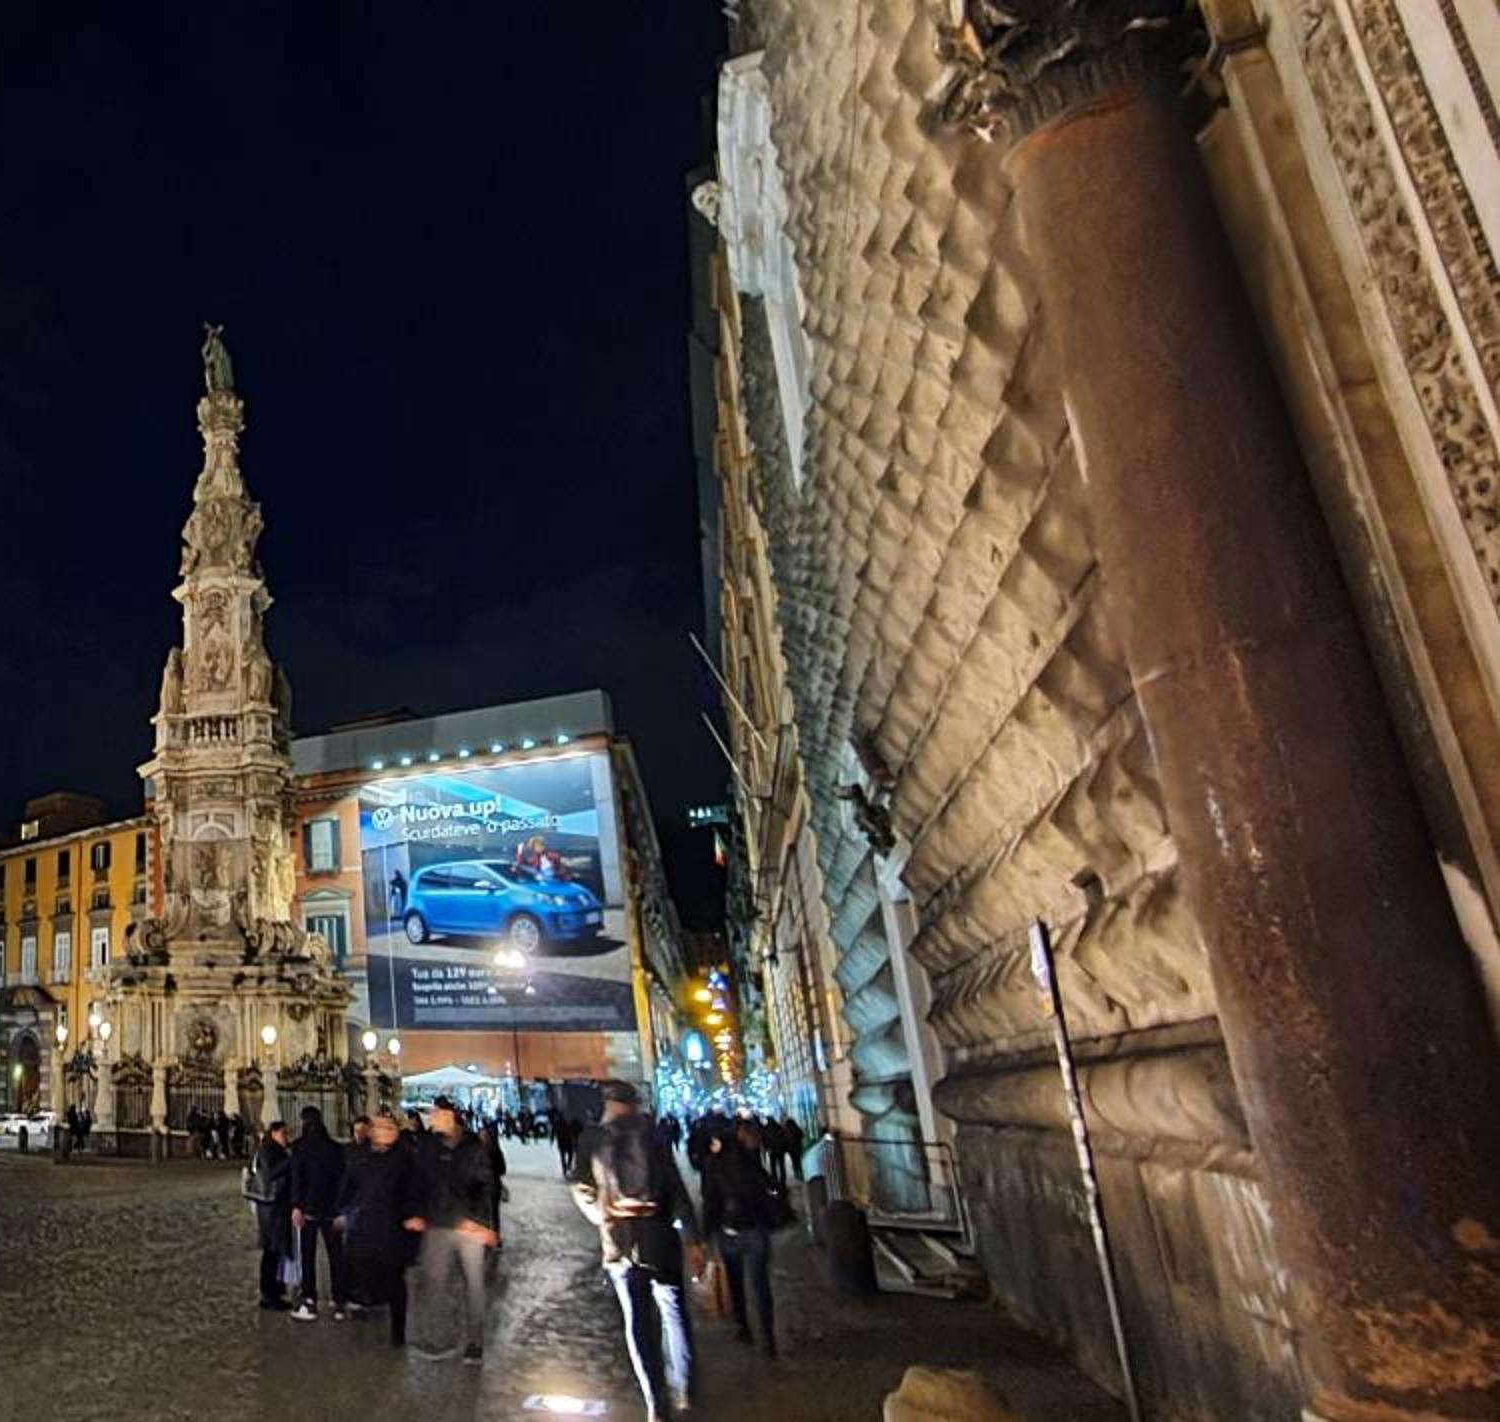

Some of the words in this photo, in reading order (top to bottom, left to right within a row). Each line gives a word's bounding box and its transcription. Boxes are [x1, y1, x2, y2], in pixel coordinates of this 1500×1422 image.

[401, 802, 465, 823] Nuova
[470, 795, 501, 817] up!
[402, 823, 480, 841] Scurdateve
